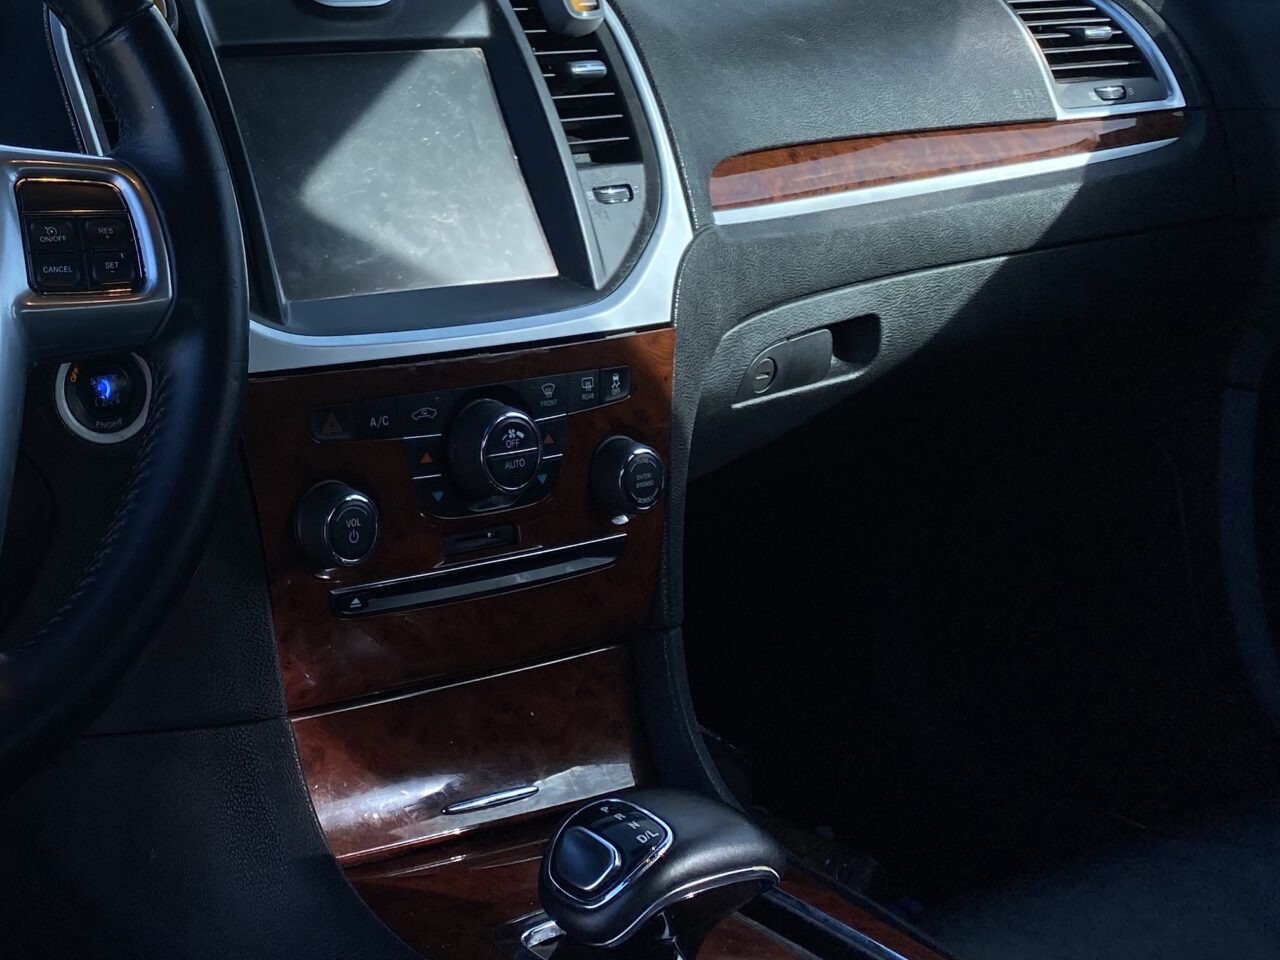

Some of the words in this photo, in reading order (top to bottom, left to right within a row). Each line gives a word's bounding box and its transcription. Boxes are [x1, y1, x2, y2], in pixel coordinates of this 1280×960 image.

[97, 227, 114, 235] RES
[39, 235, 68, 243] ON/OFF
[42, 265, 73, 274] CANCEL
[104, 261, 119, 269] SET
[370, 415, 390, 429] A/C
[505, 438, 520, 449] OFF
[504, 458, 526, 470] AUTO
[345, 517, 362, 528] VOL
